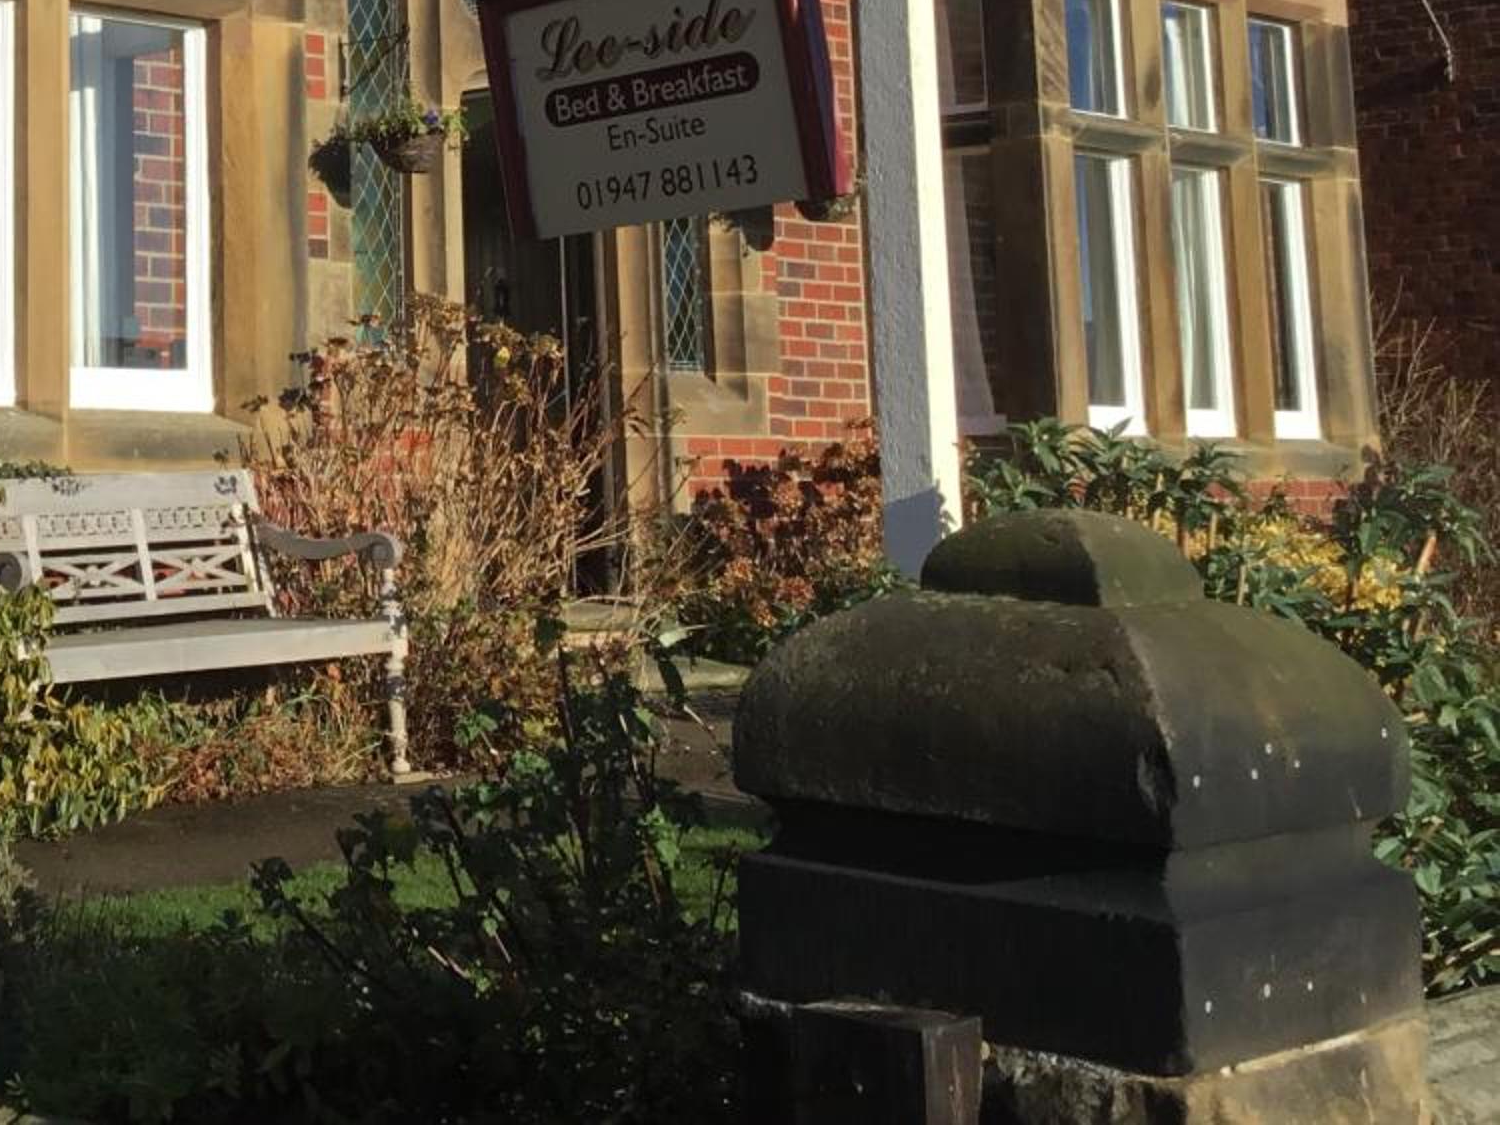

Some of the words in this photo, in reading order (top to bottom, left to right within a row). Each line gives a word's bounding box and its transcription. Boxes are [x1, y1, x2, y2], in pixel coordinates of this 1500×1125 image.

[554, 91, 599, 123] Bed
[606, 84, 628, 112] &
[632, 62, 750, 108] Breakfast
[607, 113, 707, 151] En-Suite
[576, 172, 651, 210] 01947
[660, 154, 759, 197] 881143
